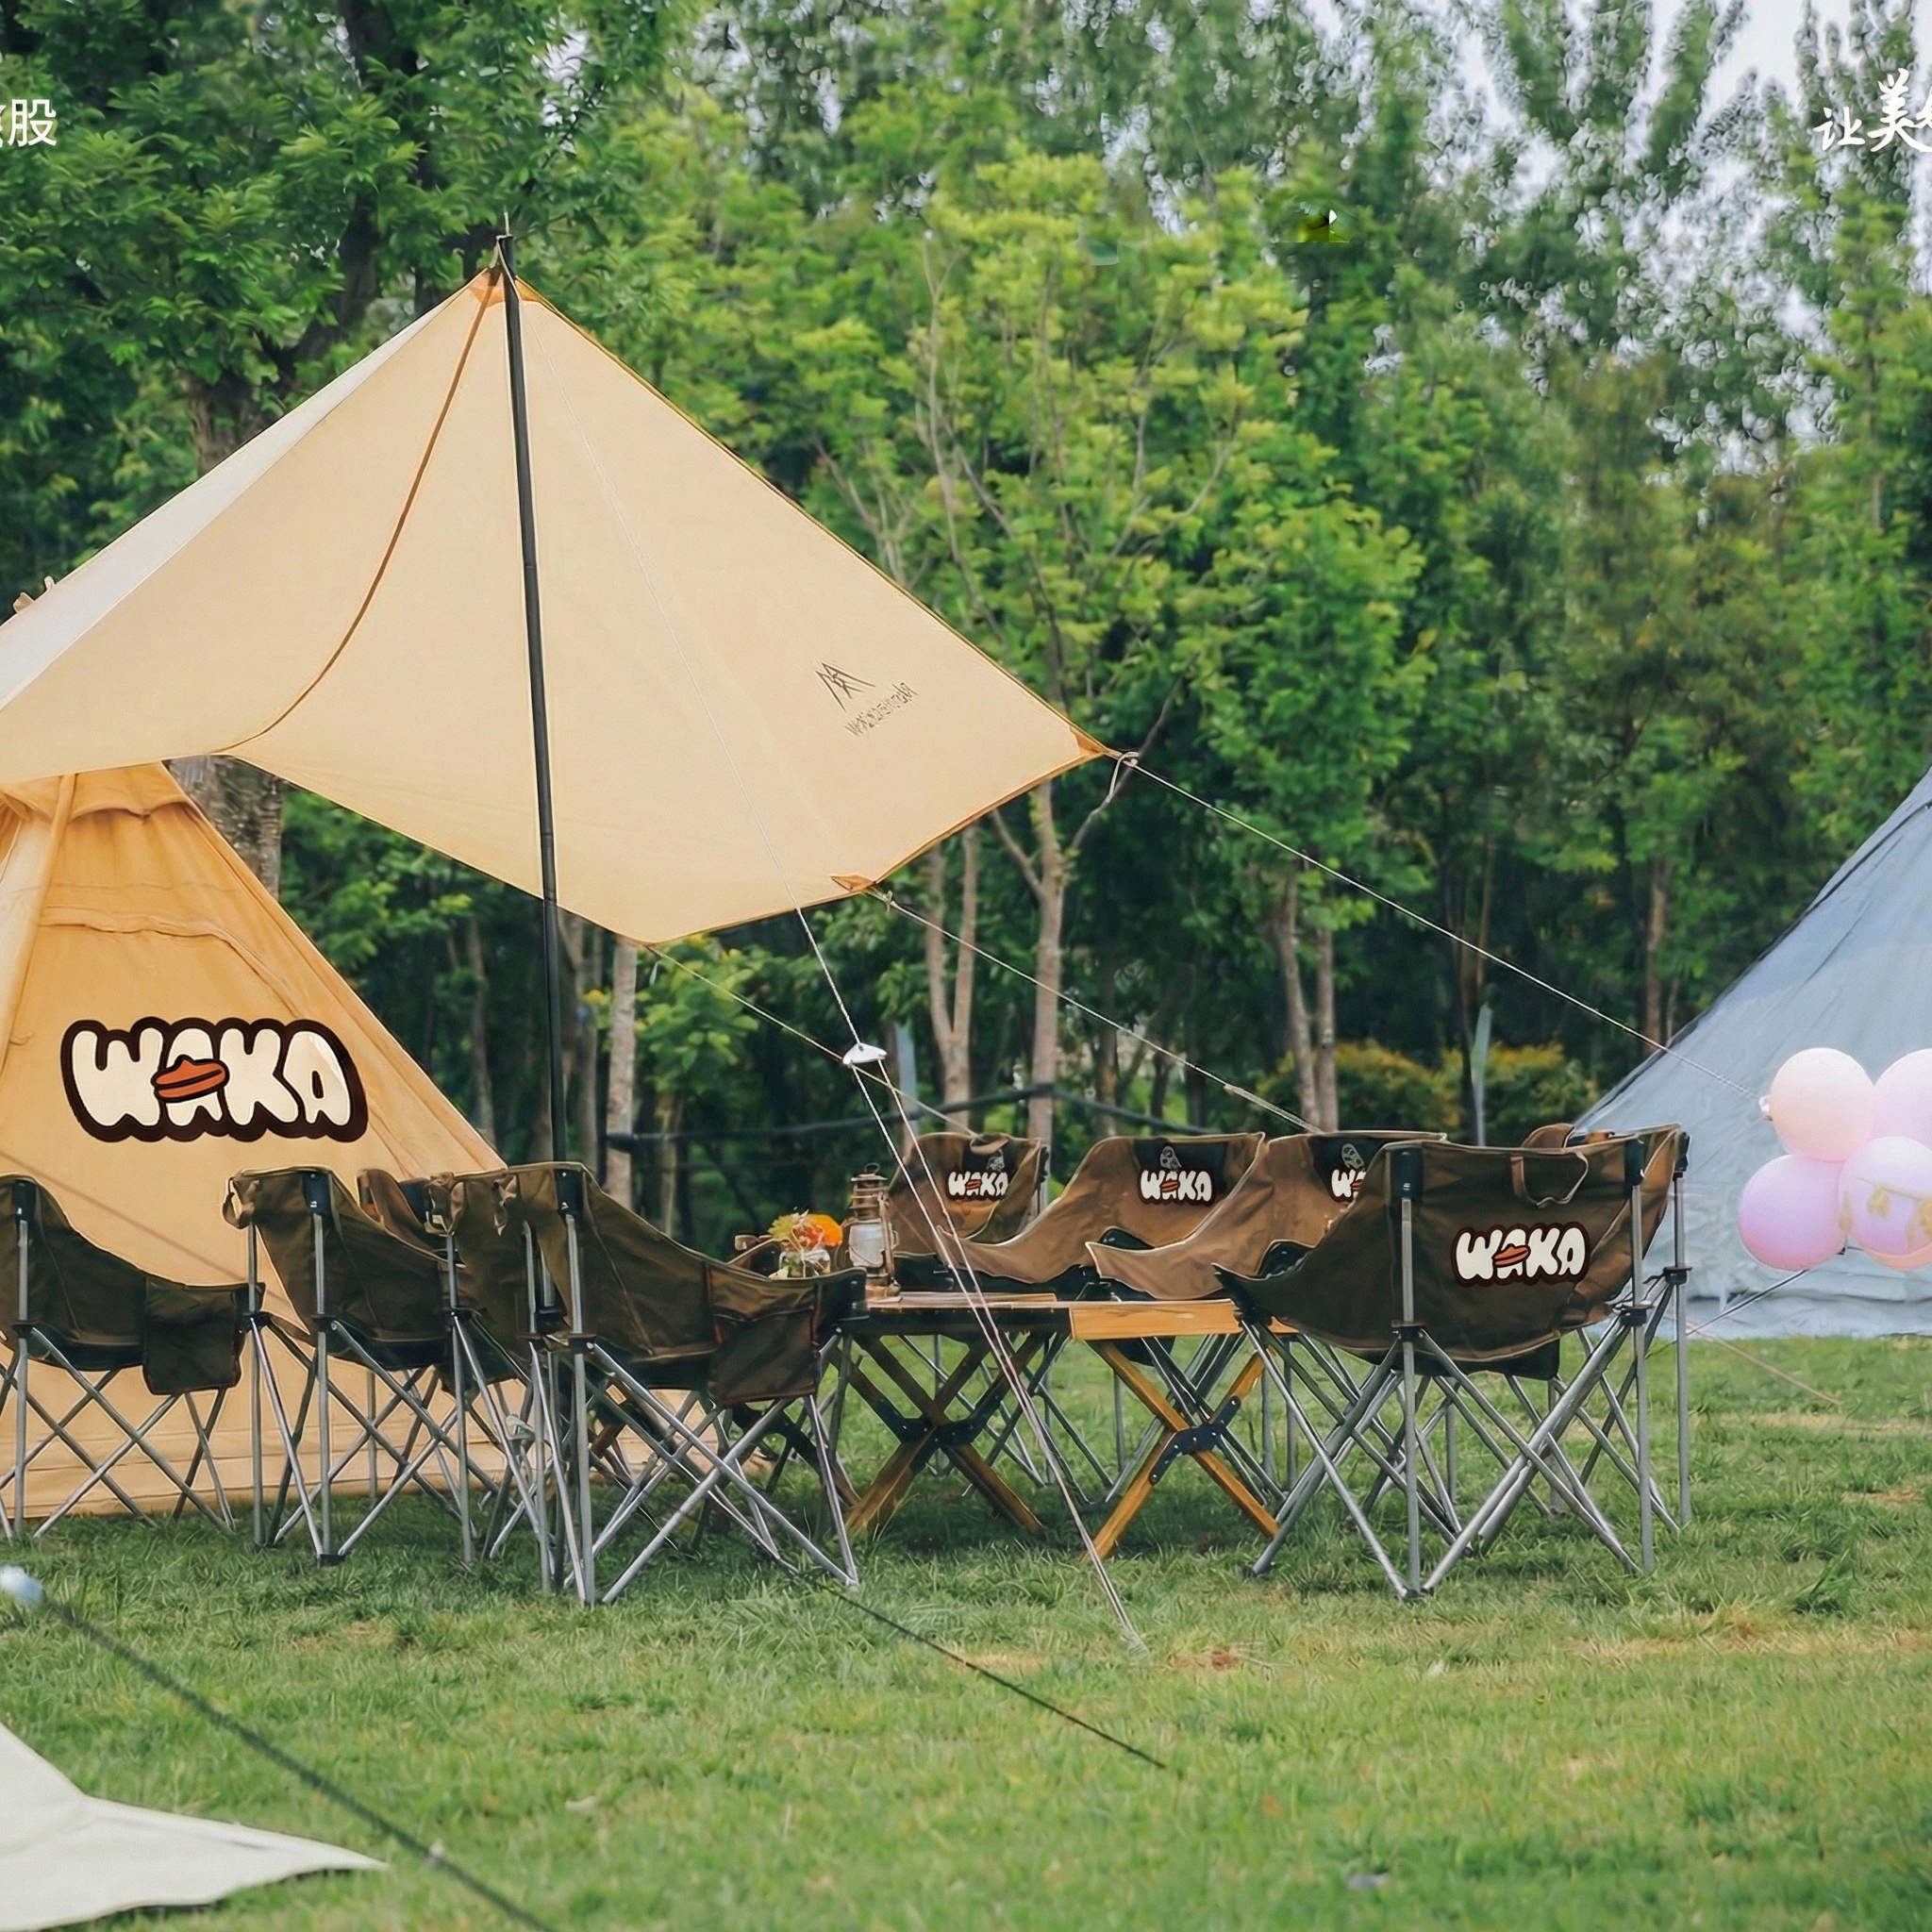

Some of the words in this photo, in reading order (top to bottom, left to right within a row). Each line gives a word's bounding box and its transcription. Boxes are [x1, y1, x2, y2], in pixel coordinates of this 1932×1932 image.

[65, 1021, 360, 1135] WAKA
[947, 1170, 1010, 1198] WAKA
[1140, 1169, 1214, 1203] WAKA
[1454, 1224, 1589, 1284] WAKA
